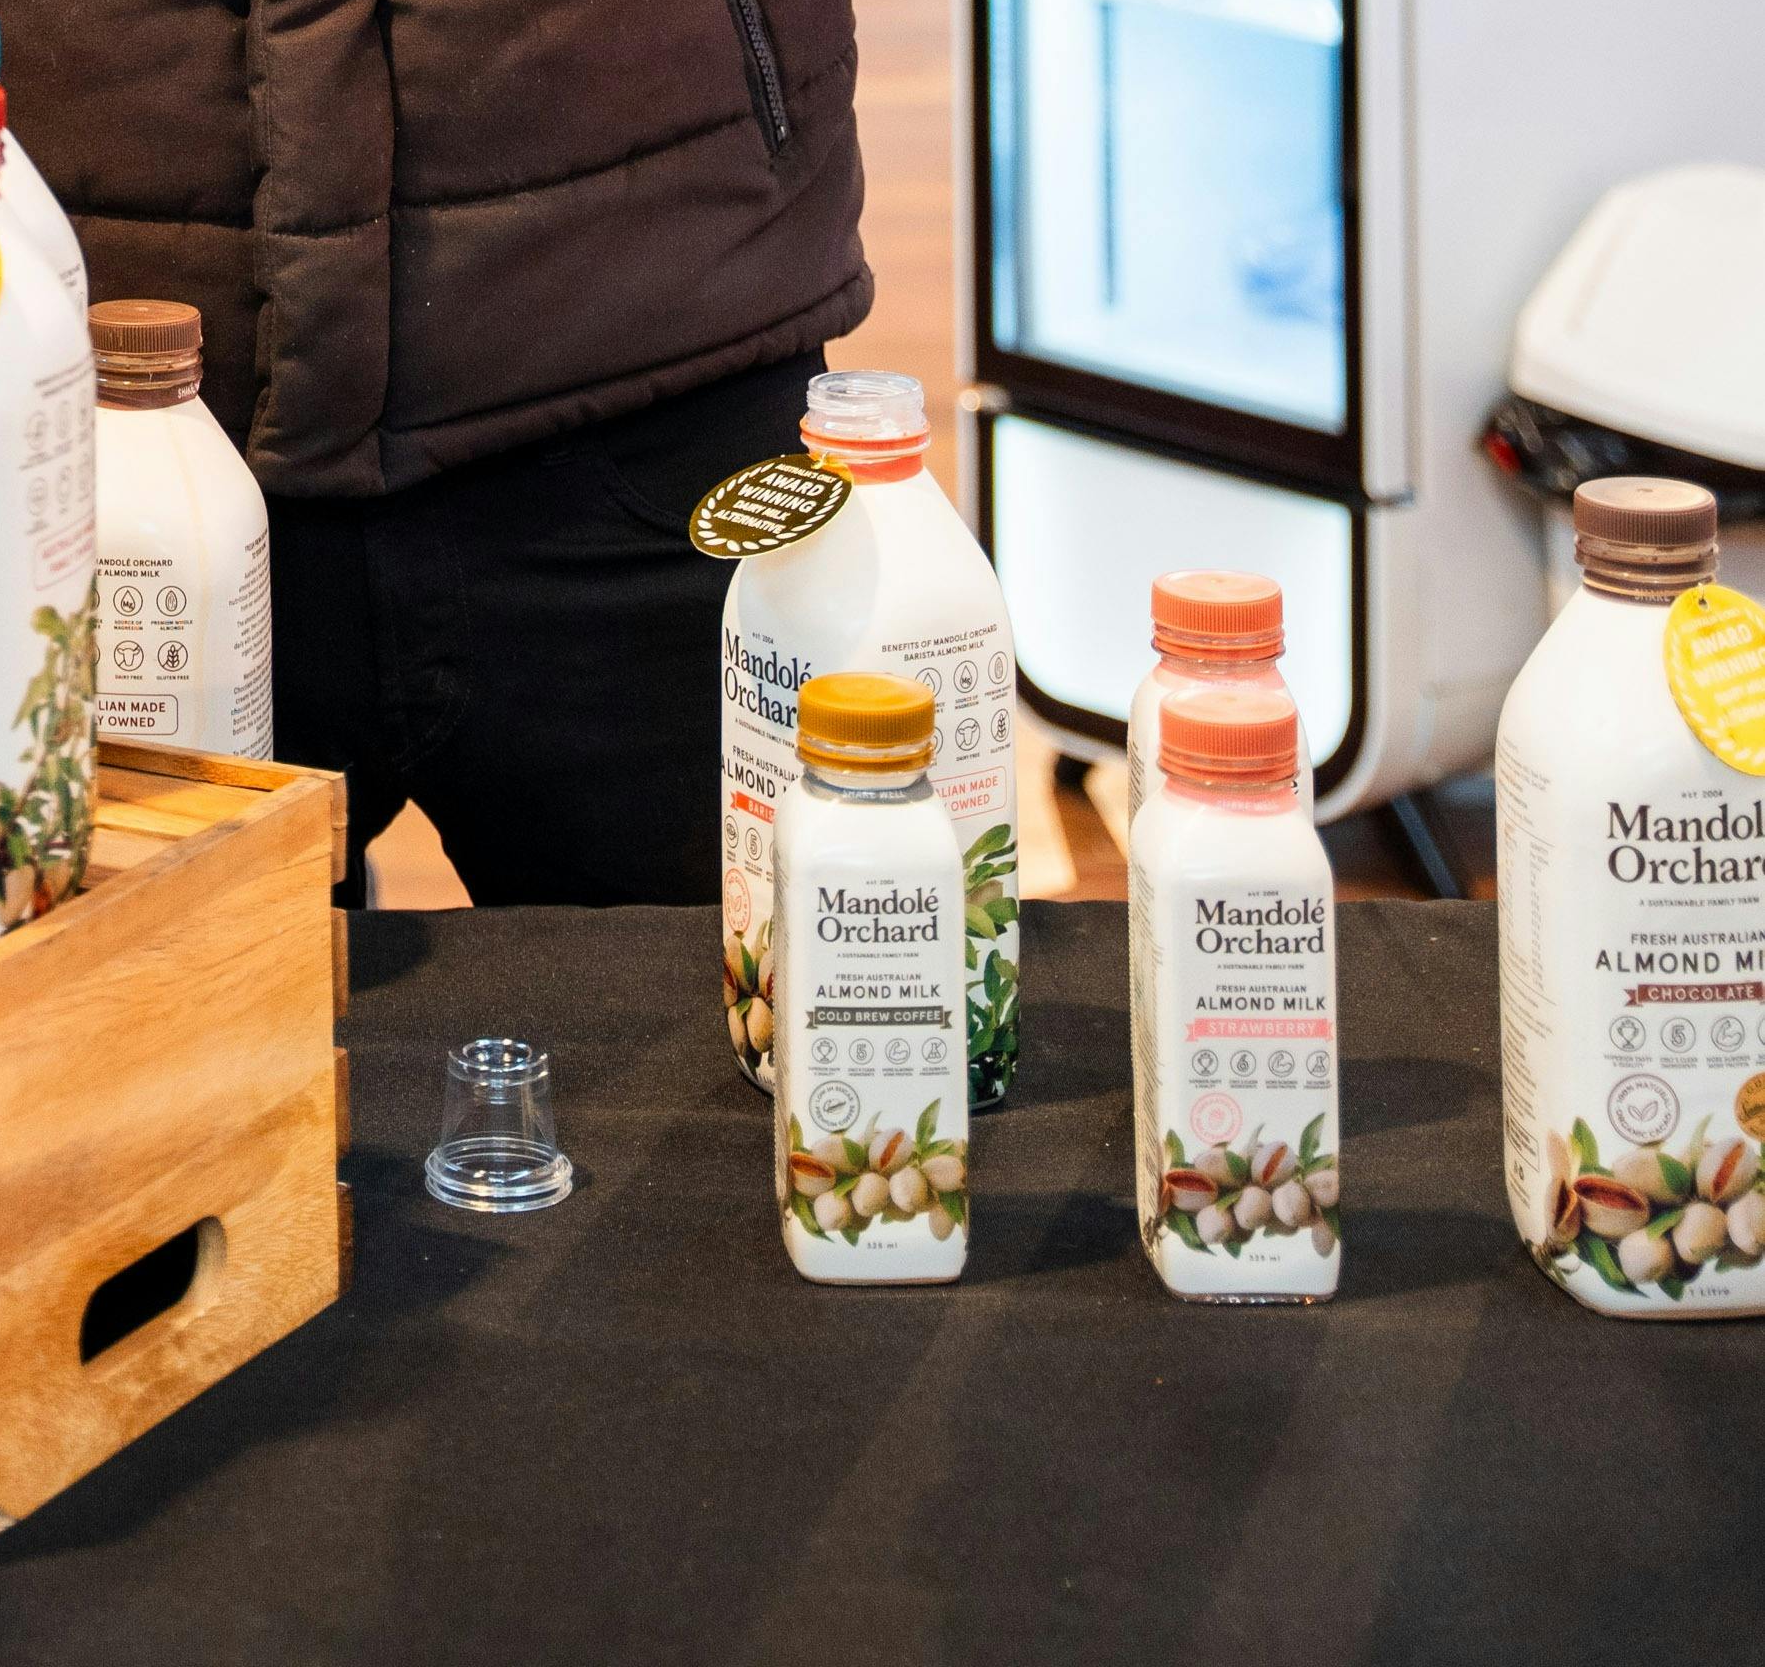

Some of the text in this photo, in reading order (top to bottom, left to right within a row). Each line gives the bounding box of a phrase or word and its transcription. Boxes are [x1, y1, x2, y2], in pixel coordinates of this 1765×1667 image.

[759, 472, 826, 497] AWARD
[738, 483, 817, 514] WINNING
[733, 499, 791, 522] DAIRY MILK
[713, 509, 787, 535] ALTERNATIVE
[96, 558, 173, 567] ANDOLÉ ORCHARD
[104, 569, 138, 577] ALMOND
[882, 623, 997, 653] BENEFITS OF MANDOLÉ ORCHARD
[724, 626, 812, 692] Mandolé
[904, 640, 985, 662] BARISTA ALMOND MILK
[130, 701, 166, 713] MADE
[725, 666, 797, 728] Orchar
[108, 716, 156, 727] OWNED
[732, 745, 799, 783] FRESH AUSTRALIA
[970, 775, 999, 791] MADE
[748, 800, 773, 821] BARIS
[951, 793, 990, 811] OWNED
[1607, 799, 1765, 843] Mandol
[1608, 845, 1765, 884] Orchar
[817, 886, 939, 915] Mandolé
[1195, 897, 1325, 926] Mandolé
[817, 915, 940, 943] Orchard
[1631, 933, 1677, 945] FRESH
[1196, 927, 1325, 954] Orchard
[1595, 950, 1765, 973] ALMOND MI
[836, 973, 921, 981] FRESH AUSTRALIAN
[816, 984, 940, 999] ALMOND MILK
[1216, 985, 1307, 993] FRESH AUSTRALIAN
[1647, 985, 1755, 1001] CHOCOLATE
[1196, 996, 1327, 1011] ALMOND MILK
[817, 1010, 941, 1022] COLD BREW COFFEE
[1208, 1021, 1317, 1035] STRAWBERRY
